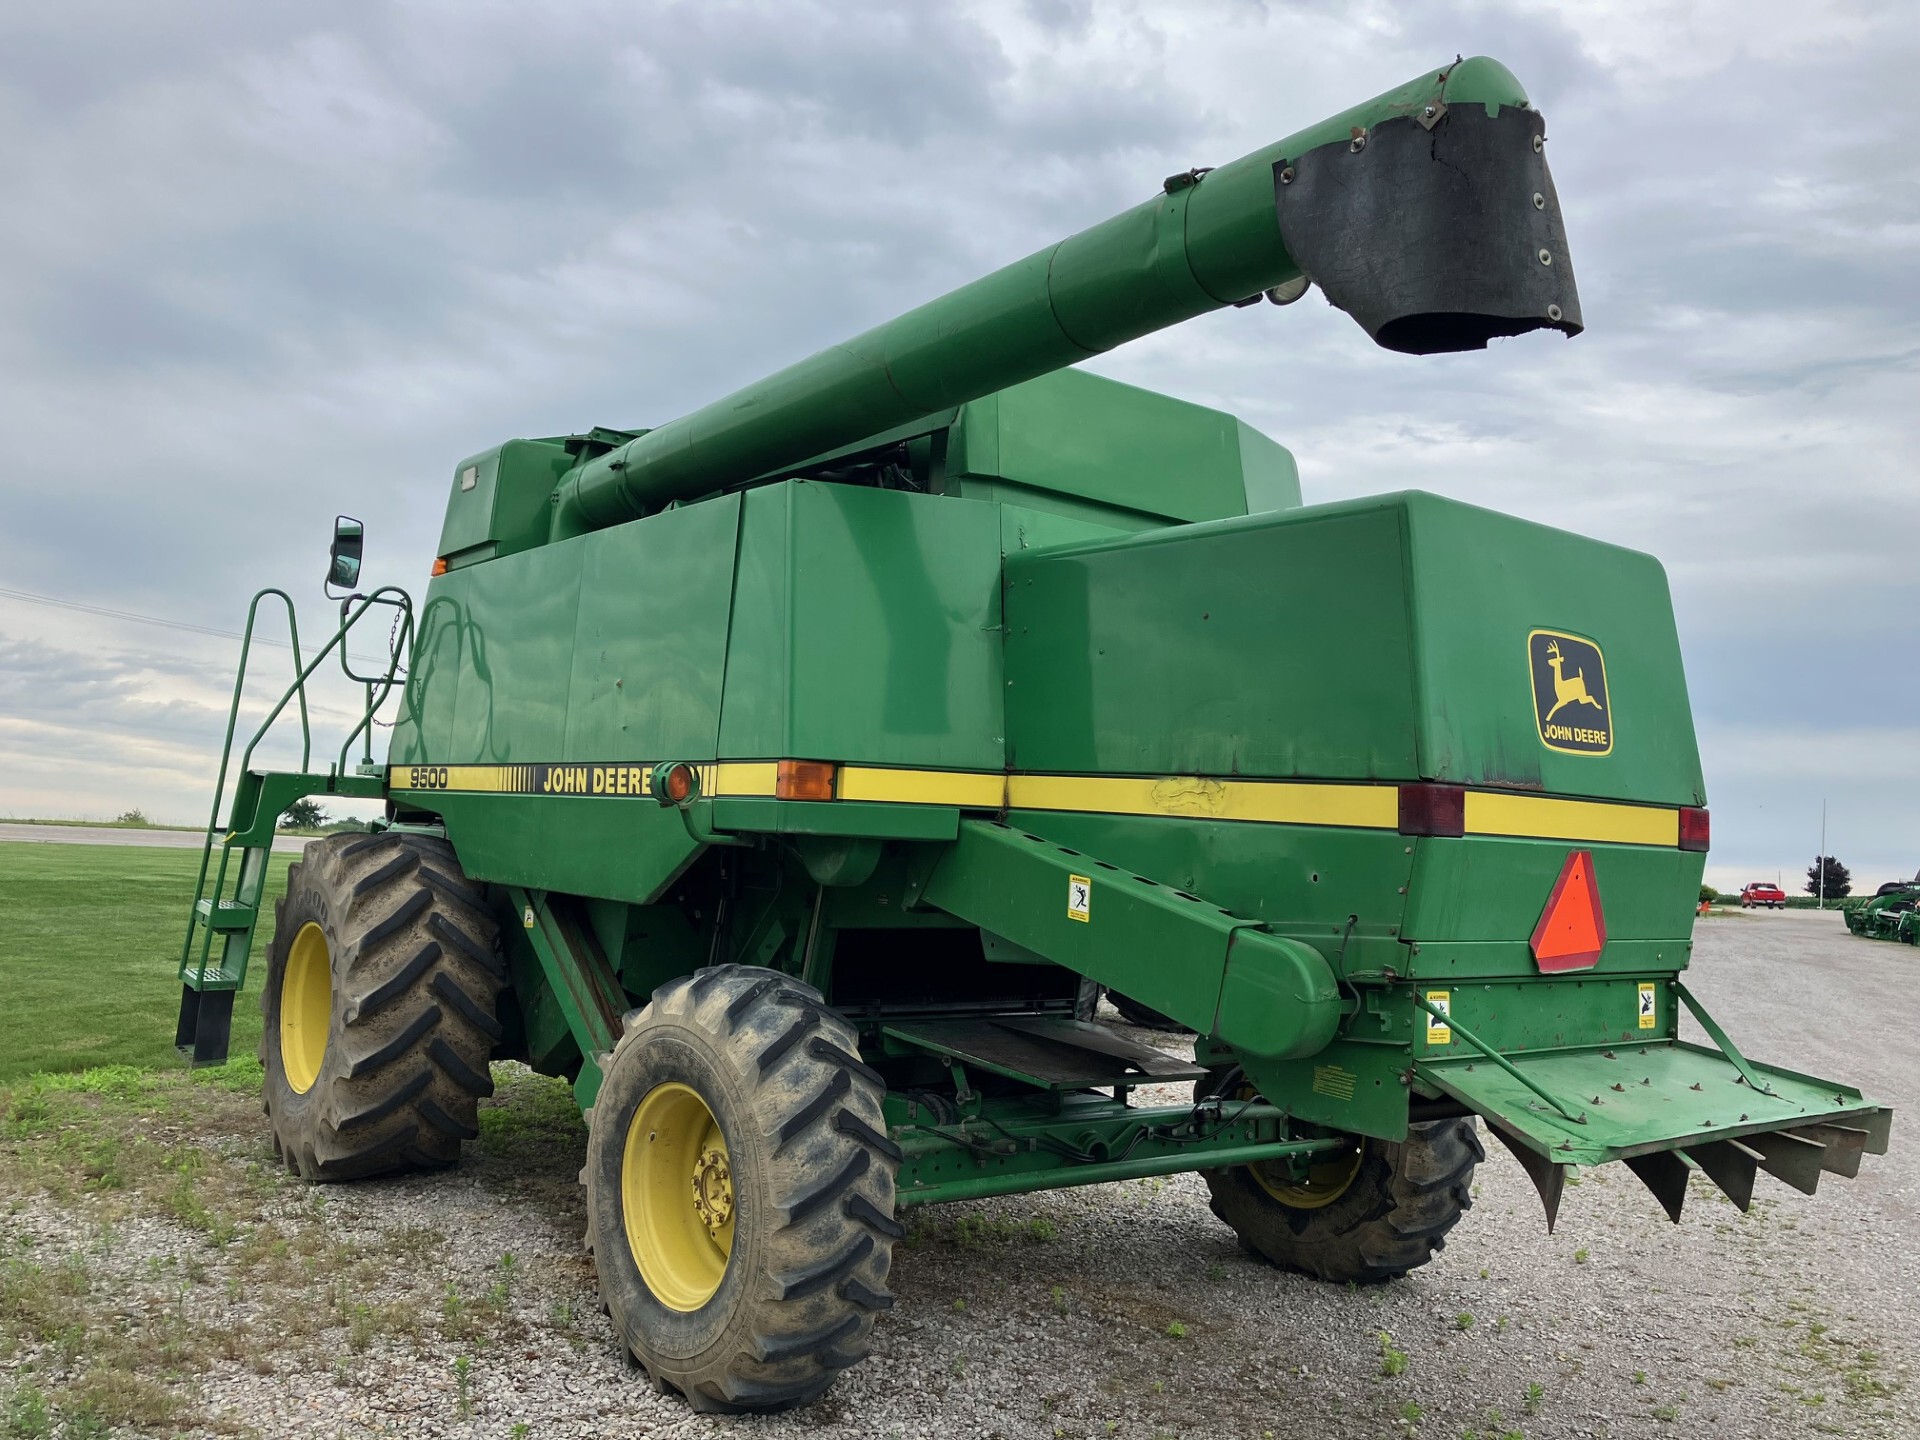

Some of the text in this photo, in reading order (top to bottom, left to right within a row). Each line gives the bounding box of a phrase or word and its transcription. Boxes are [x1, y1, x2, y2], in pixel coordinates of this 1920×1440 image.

[1544, 724, 1607, 744] JOHN DEERE
[410, 767, 448, 789] 9500
[543, 767, 653, 794] JOHN DEERE
